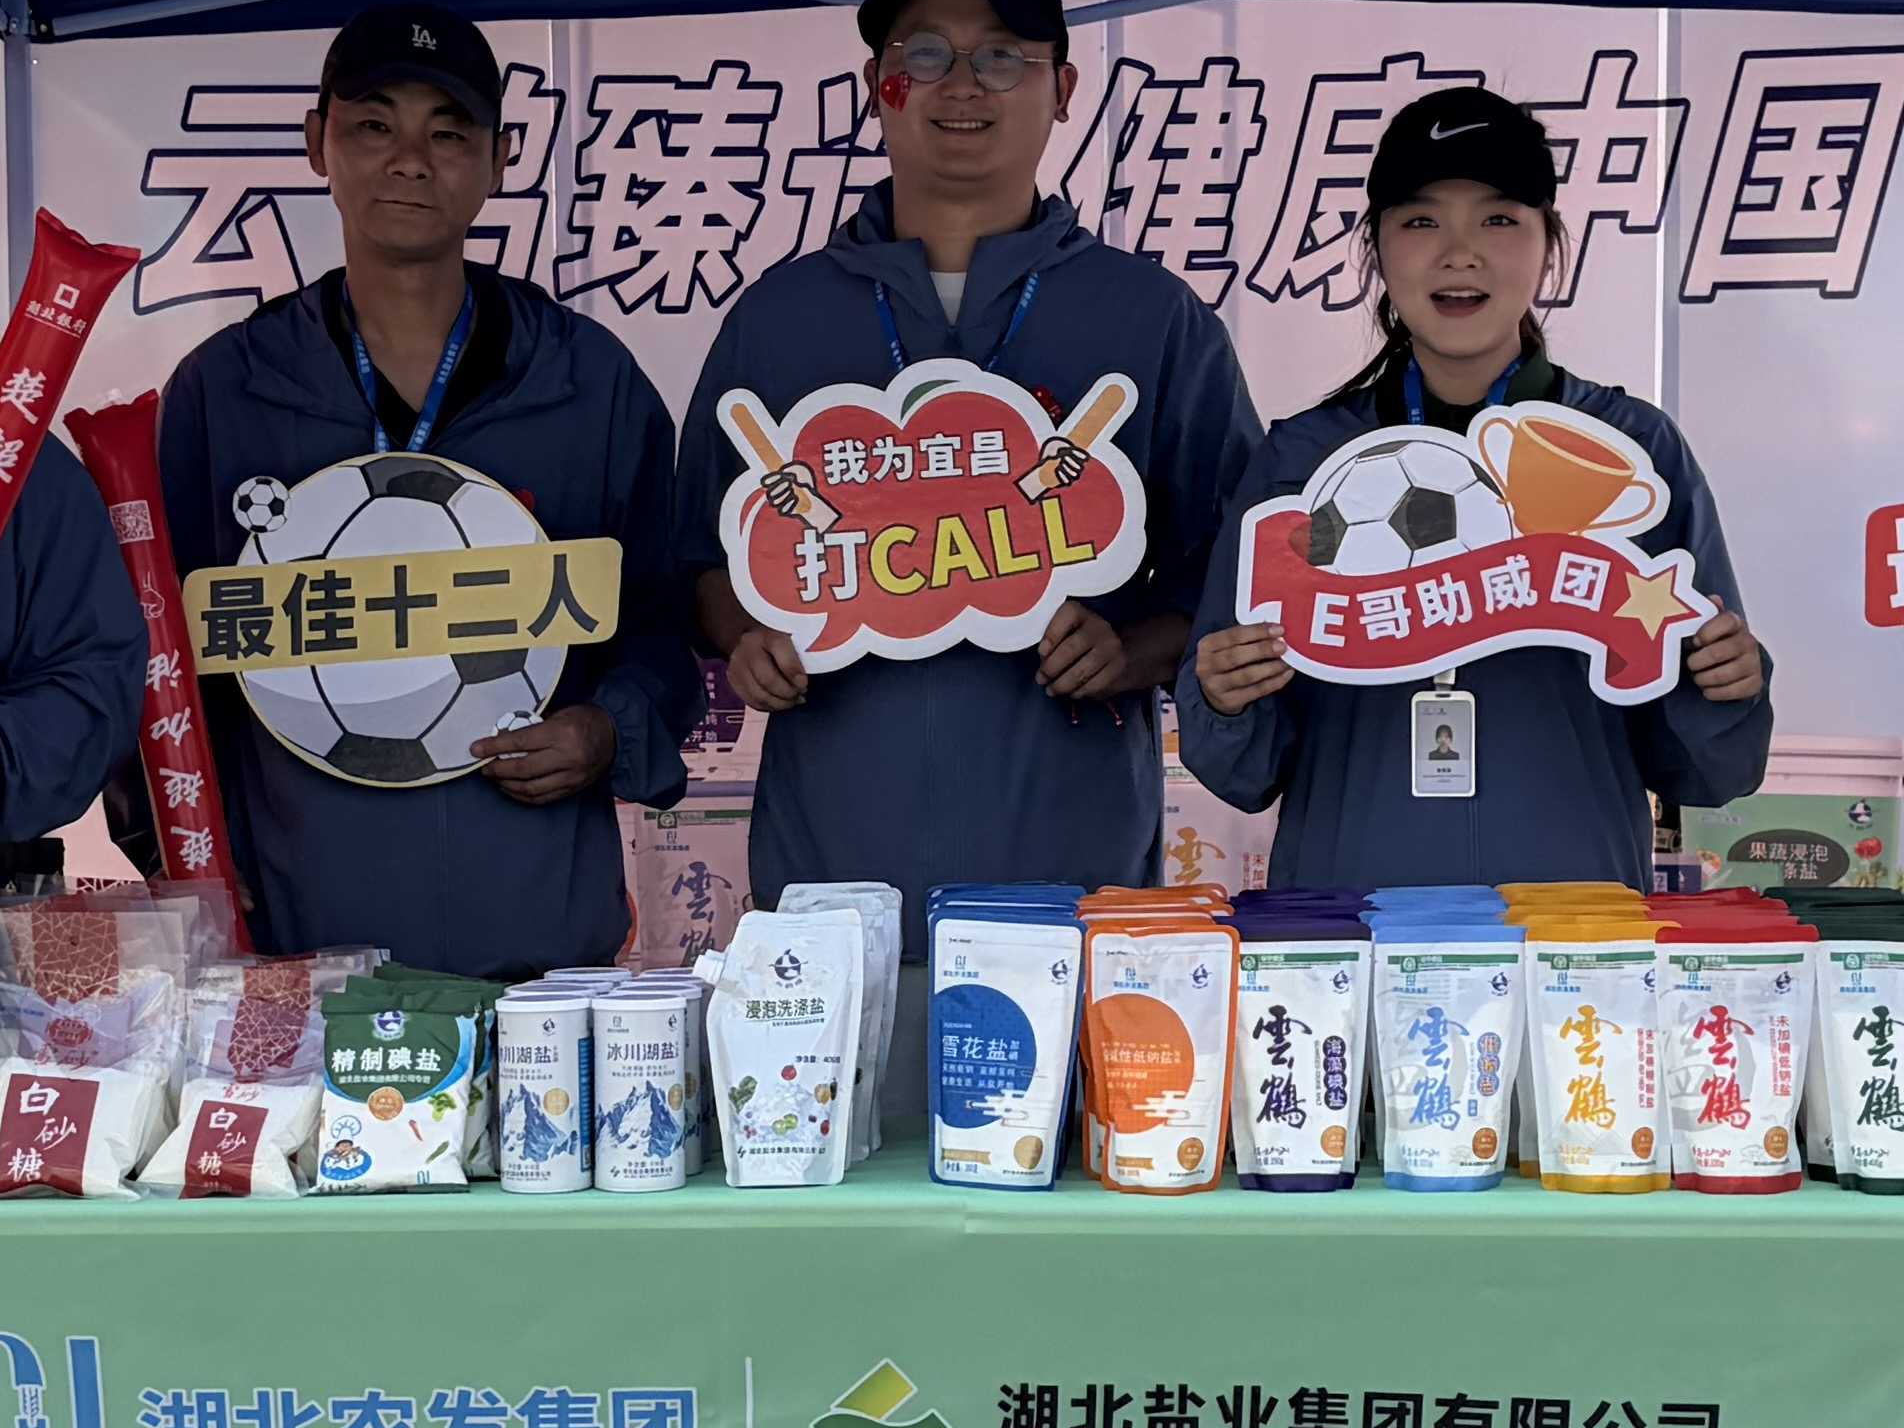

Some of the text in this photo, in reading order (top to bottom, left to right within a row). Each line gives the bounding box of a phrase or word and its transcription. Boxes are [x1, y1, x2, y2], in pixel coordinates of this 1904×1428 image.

[412, 24, 437, 50] LA
[823, 430, 1012, 486] 我为宜昌
[793, 496, 1099, 604] 打CALL
[200, 552, 600, 663] 最佳十二人
[1310, 554, 1612, 647] E哥助威团
[1749, 842, 1830, 863] 果蔬浸泡
[746, 997, 826, 1020] 浸泡洗涤盐
[331, 1046, 441, 1073] 精制碘盐
[607, 1042, 675, 1062] 冰川湖盐
[942, 1035, 1008, 1062] 雪花盐
[7, 1081, 79, 1183] 白砂糖
[196, 1107, 248, 1178] 白砂糖
